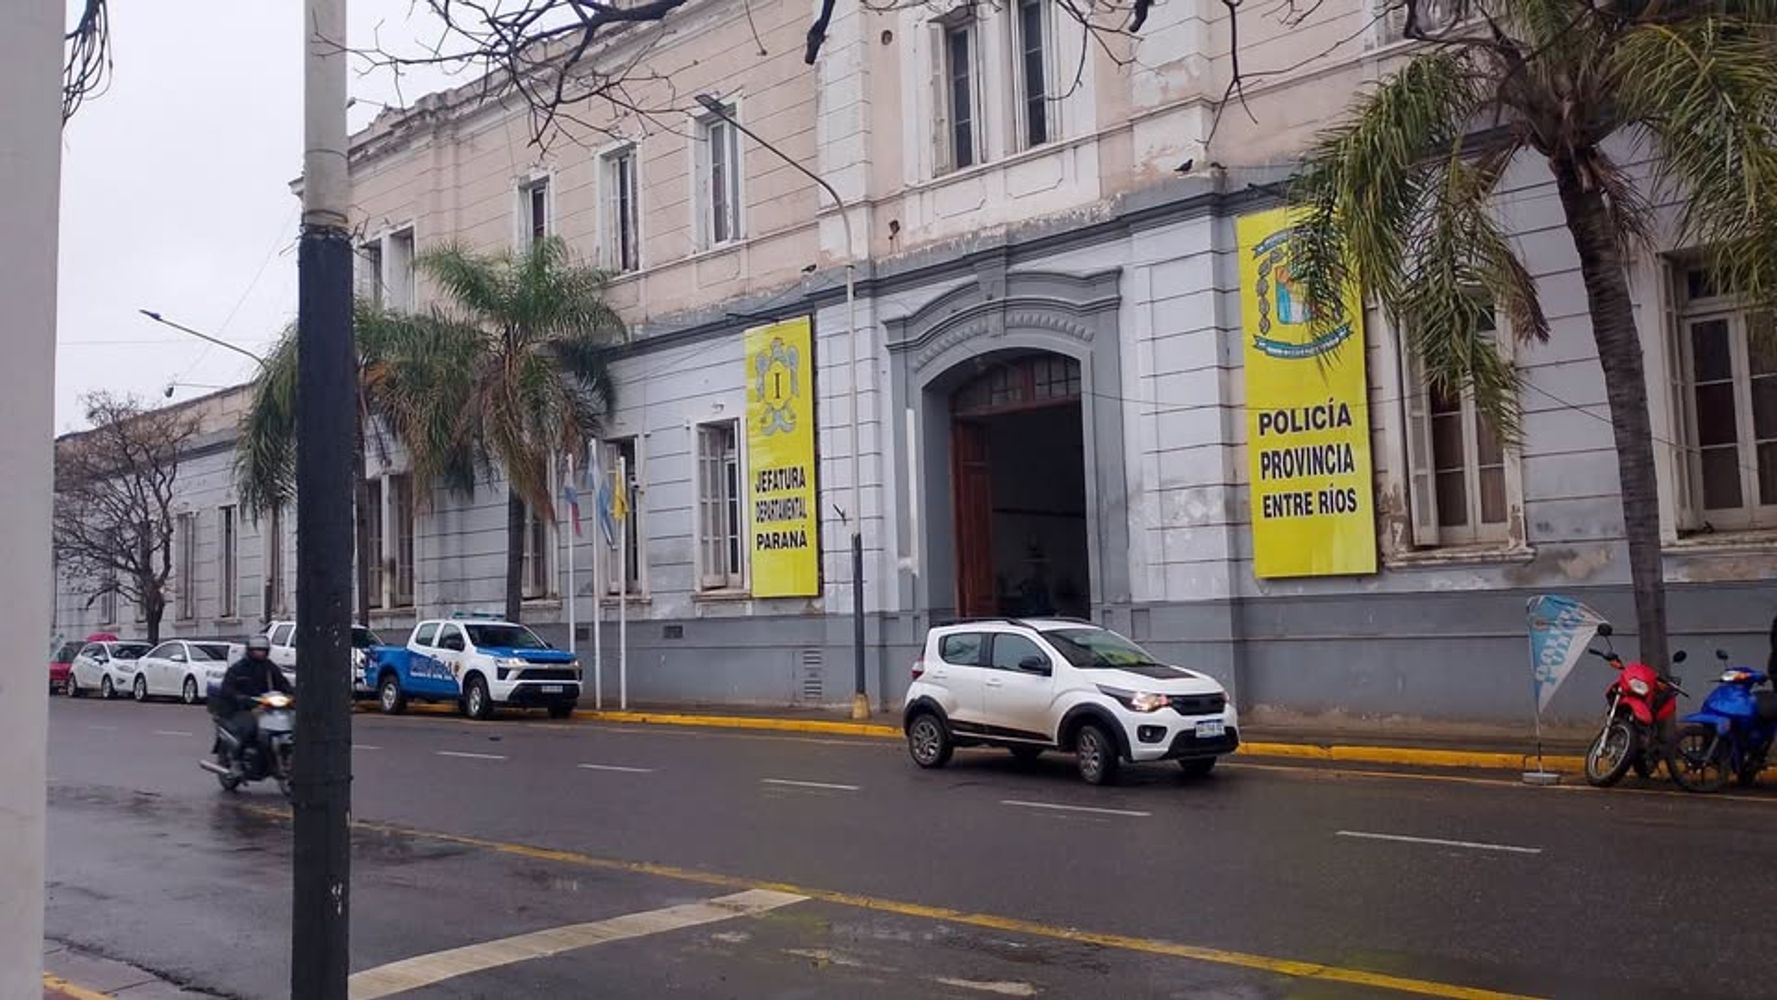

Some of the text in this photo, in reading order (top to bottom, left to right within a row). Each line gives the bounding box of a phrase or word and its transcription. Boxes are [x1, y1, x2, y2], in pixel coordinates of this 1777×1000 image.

[1258, 397, 1352, 436] POLICÍA
[1260, 443, 1355, 480] PROVINCIA
[755, 466, 806, 493] JEFATURA
[1262, 483, 1357, 518] ENTRE RÍOS
[756, 524, 808, 551] PARANÁ
